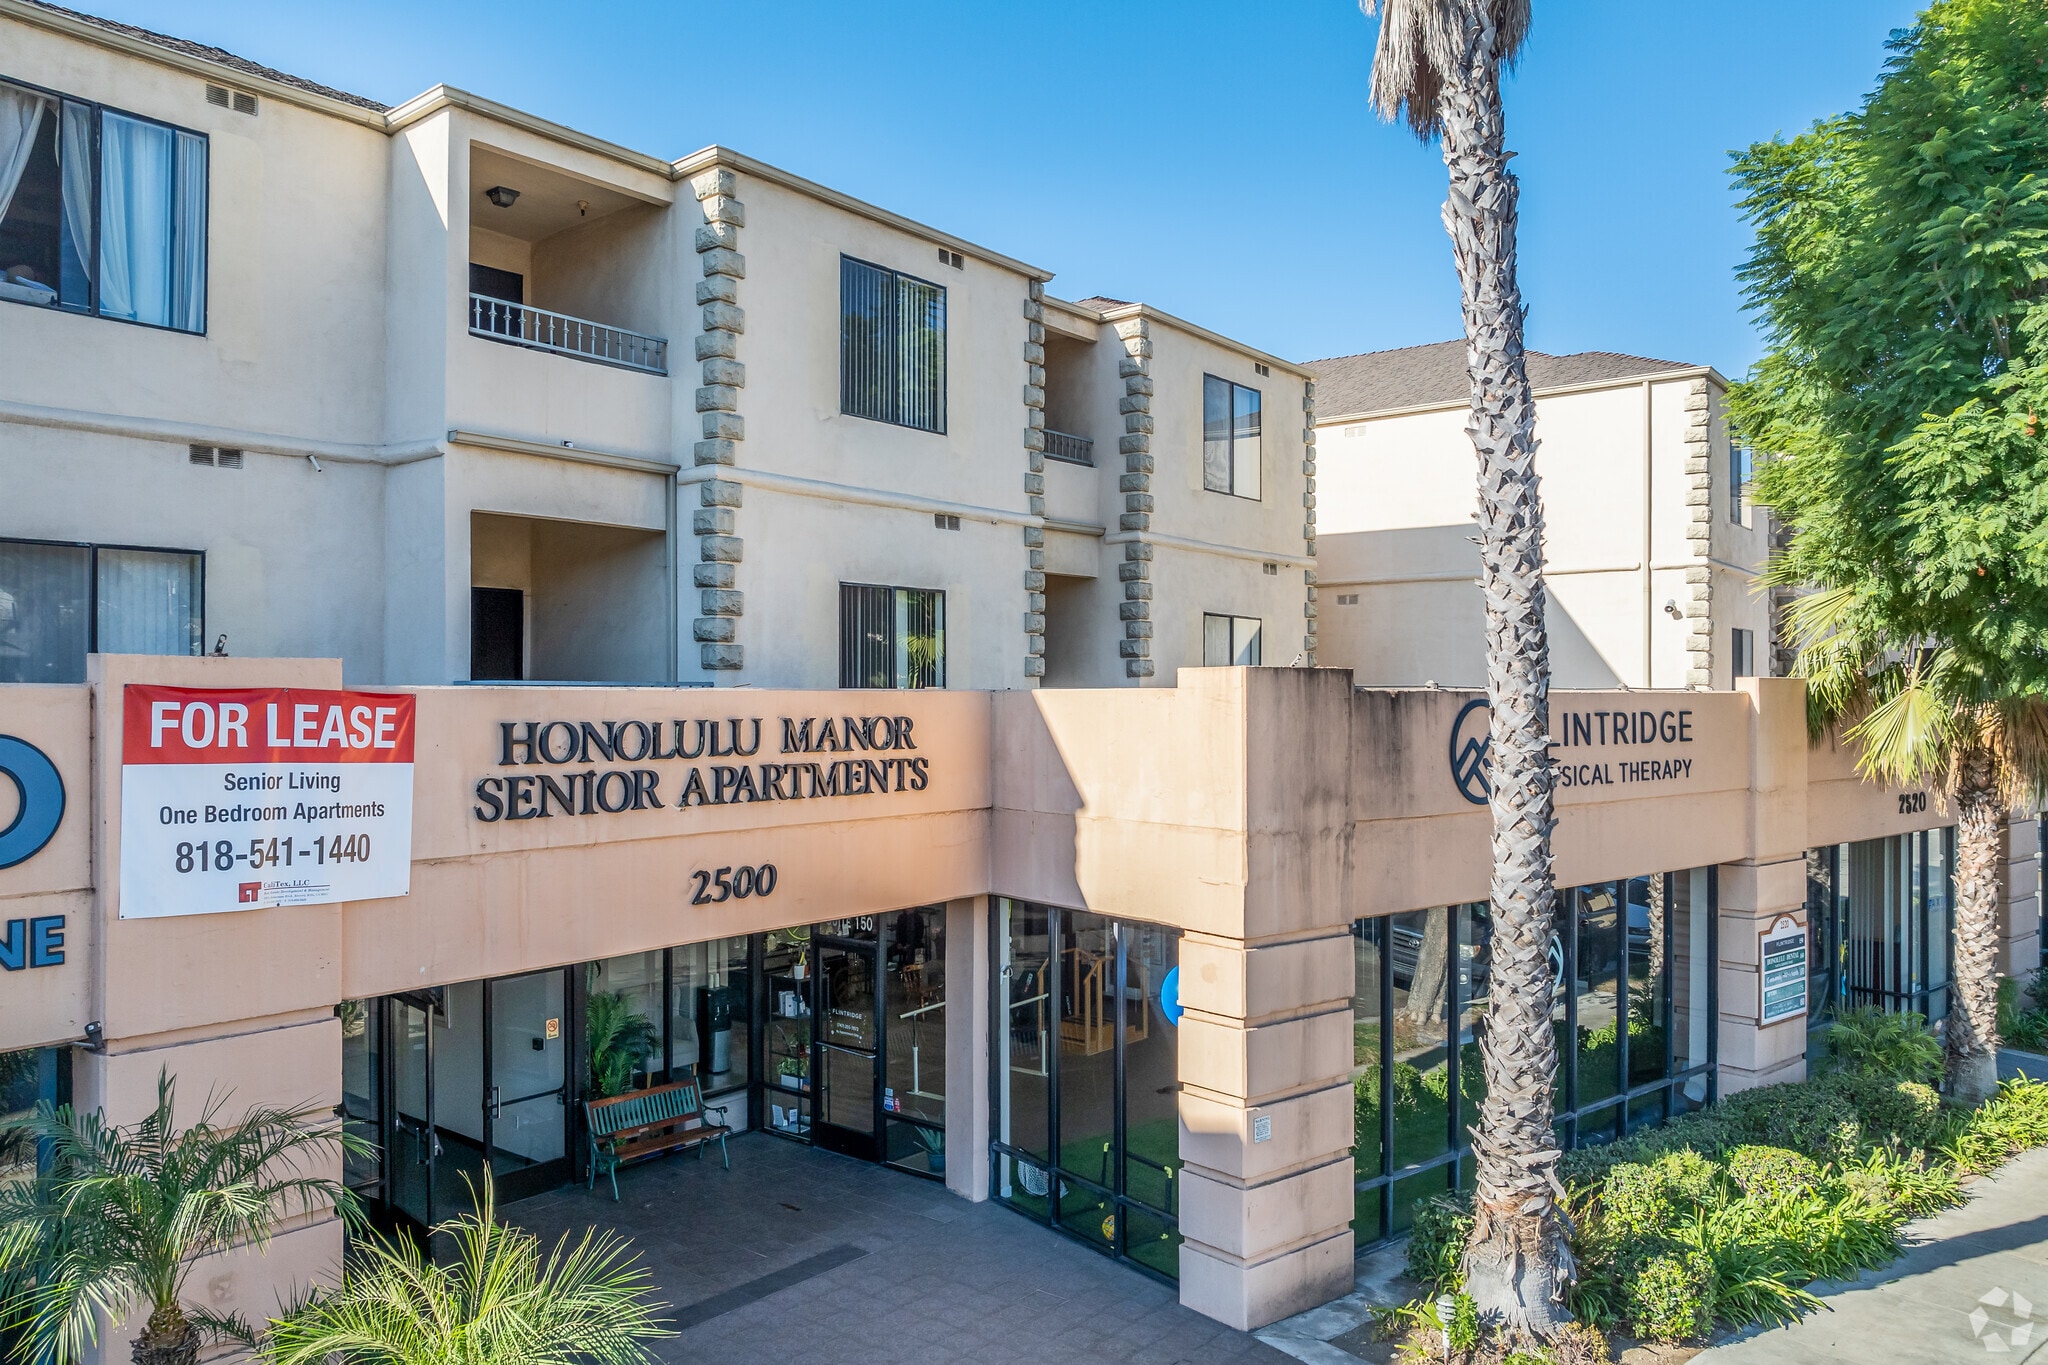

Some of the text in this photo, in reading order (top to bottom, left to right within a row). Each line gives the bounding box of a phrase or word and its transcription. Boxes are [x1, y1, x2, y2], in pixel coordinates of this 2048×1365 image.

[151, 701, 397, 749] FOR LEASE
[499, 715, 917, 766] HONOLULU MANOR
[224, 772, 341, 793] Senior Living
[1619, 758, 1692, 784] THERAPY
[474, 757, 929, 823] SENIOR APARTMENTS
[1899, 791, 1926, 814] 2520
[160, 801, 385, 825] One Bedroom Apartments
[175, 833, 371, 874] 818-541-1440
[293, 879, 309, 887] LLC
[690, 863, 778, 906] 2500
[856, 916, 873, 931] 150
[832, 1008, 863, 1020] FLINTRIDGE
